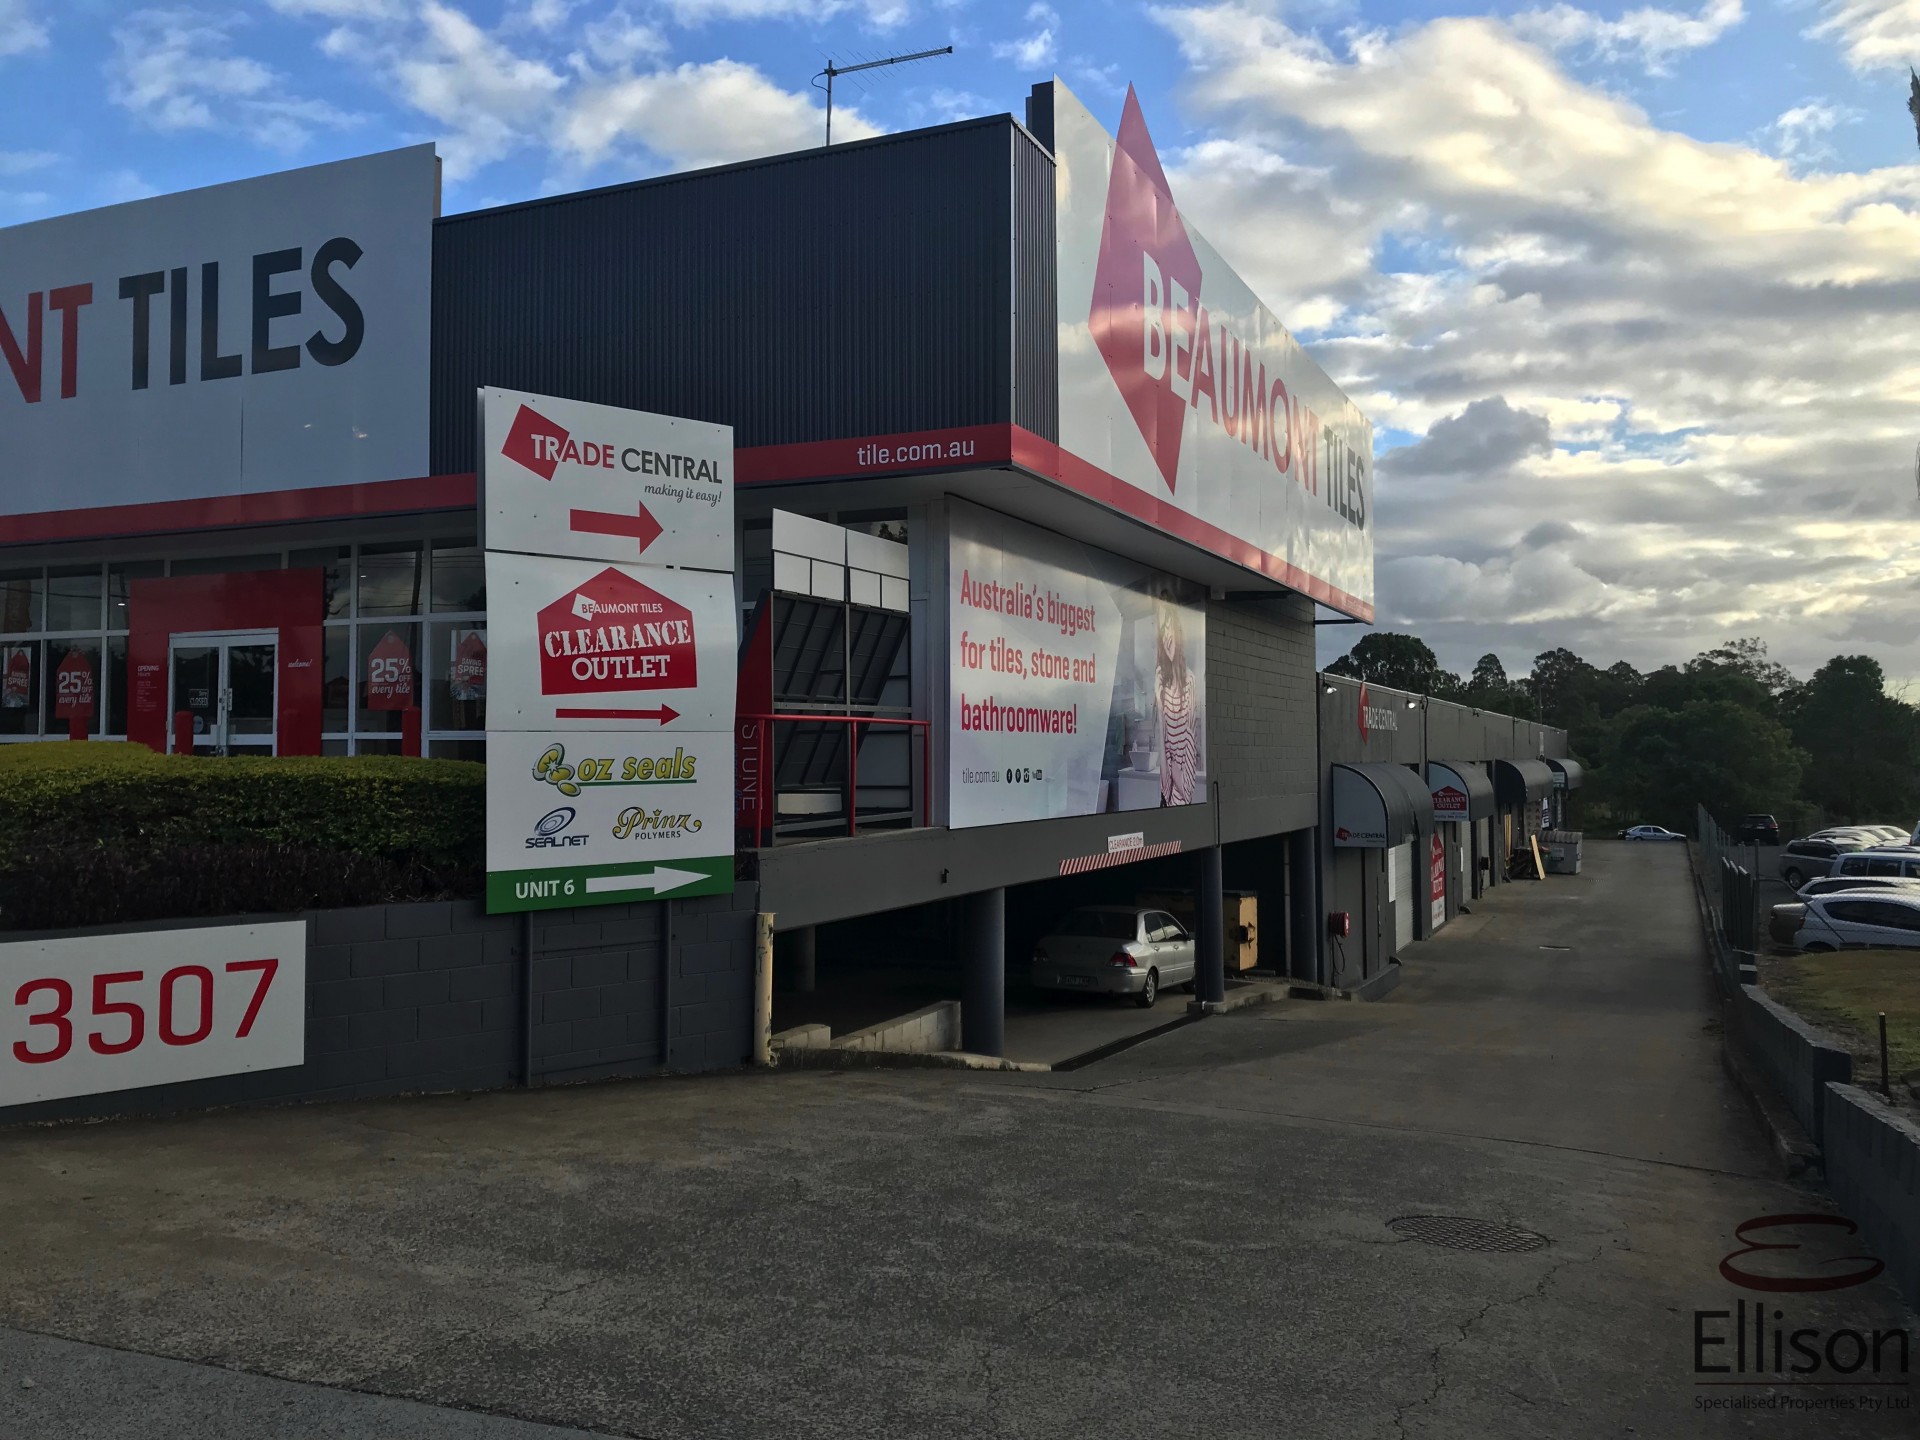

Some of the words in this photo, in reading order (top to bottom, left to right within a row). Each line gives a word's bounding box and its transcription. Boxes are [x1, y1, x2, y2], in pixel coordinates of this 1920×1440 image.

[118, 237, 365, 391] TILES
[1143, 250, 1319, 497] BEAUMONT
[1323, 424, 1365, 531] TILES
[530, 433, 615, 469] TRADE
[621, 448, 723, 484] CENTRAL
[857, 440, 975, 466] tile.com.au
[644, 484, 683, 503] making
[686, 487, 694, 499] it
[695, 490, 722, 507] easy!
[581, 603, 638, 614] BEAUMONT
[641, 603, 663, 614] TILES
[961, 569, 1044, 621] Australia's
[1047, 590, 1096, 637] biggest
[544, 619, 691, 658] CLEARANCE
[571, 655, 671, 681] OUTLET
[961, 630, 985, 670] for
[989, 637, 1027, 680] tiles,
[1031, 648, 1070, 681] stone
[1073, 653, 1096, 684] and
[8, 676, 28, 688] SPREE
[457, 664, 484, 677] SPREE
[59, 695, 77, 708] every
[372, 684, 393, 698] every
[395, 682, 410, 695] tile
[961, 693, 1077, 735] bathroomware!
[577, 757, 615, 782] oz
[621, 747, 697, 780] seals
[962, 768, 1000, 784] tile.com.au
[612, 806, 703, 840] Prinz
[634, 830, 681, 841] POLYMERS
[525, 834, 590, 849] SEALNET
[515, 880, 560, 899] UNIT
[563, 879, 575, 895] 6
[12, 958, 279, 1064] 3507
